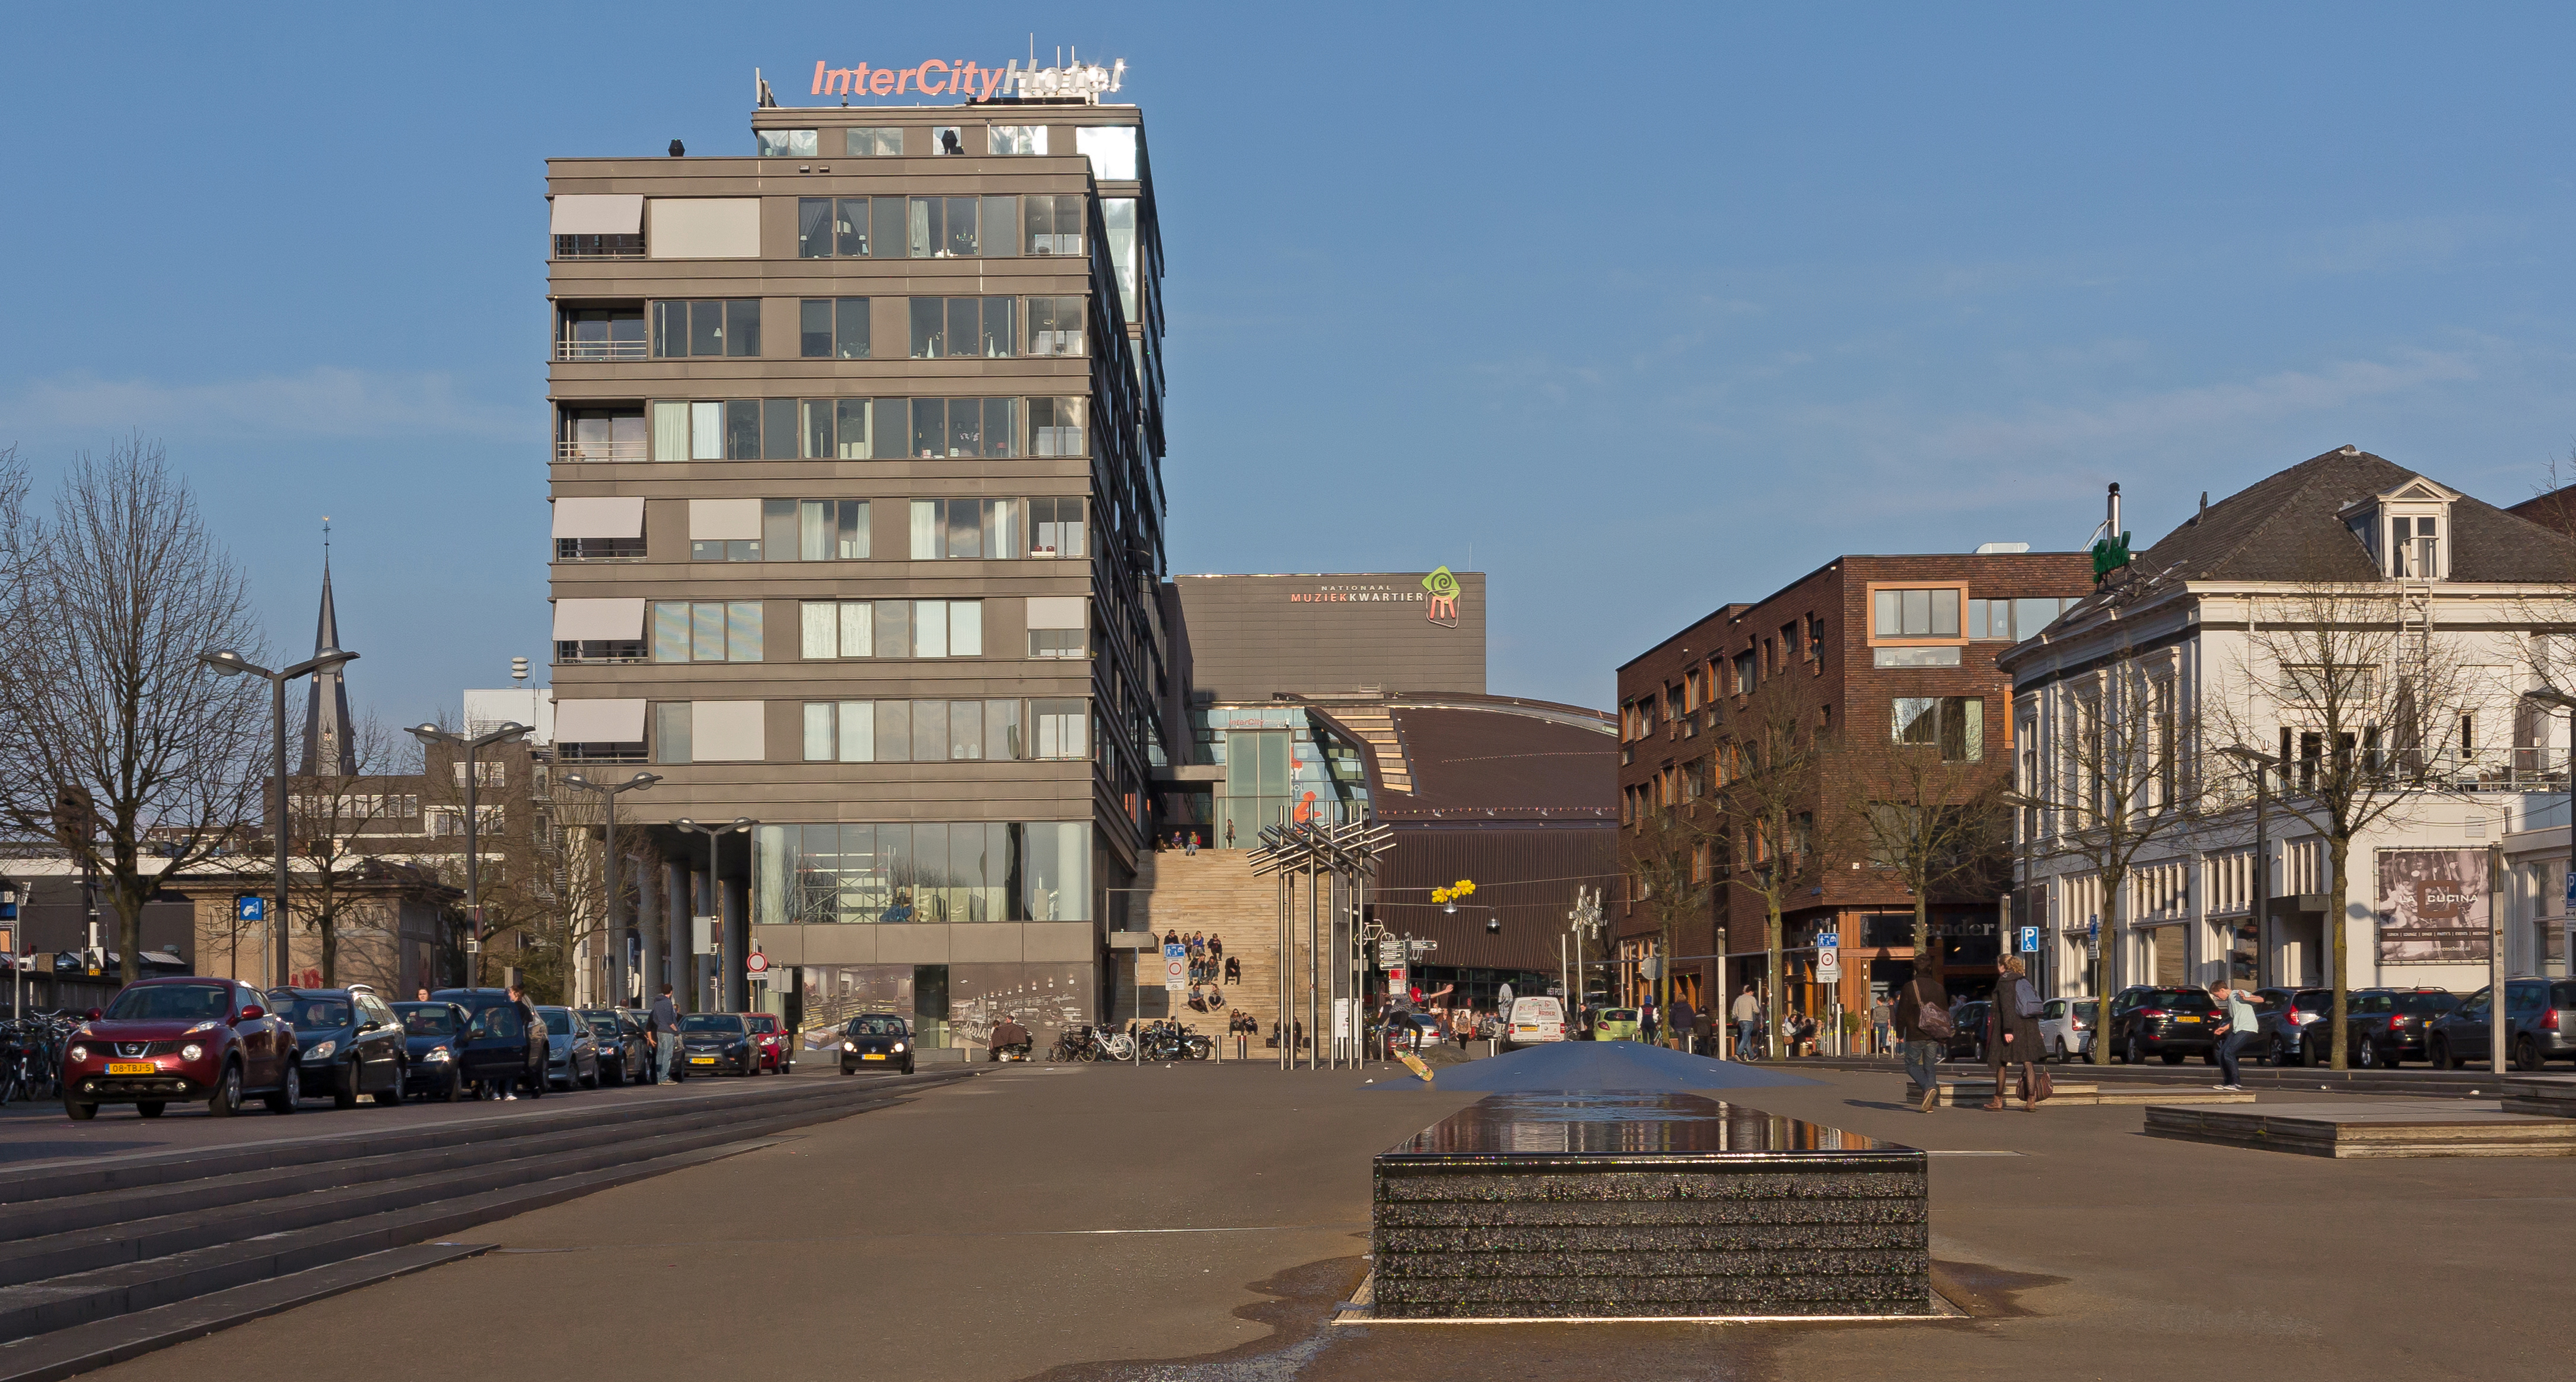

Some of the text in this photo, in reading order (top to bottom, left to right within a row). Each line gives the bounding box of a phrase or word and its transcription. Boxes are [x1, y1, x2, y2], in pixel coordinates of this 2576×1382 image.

[811, 58, 1124, 101] InterCityHotel
[1291, 592, 1424, 603] MUZIEKKWARTIER
[2568, 875, 2575, 893] P
[2427, 894, 2479, 903] CUCINA
[2024, 928, 2035, 941] P
